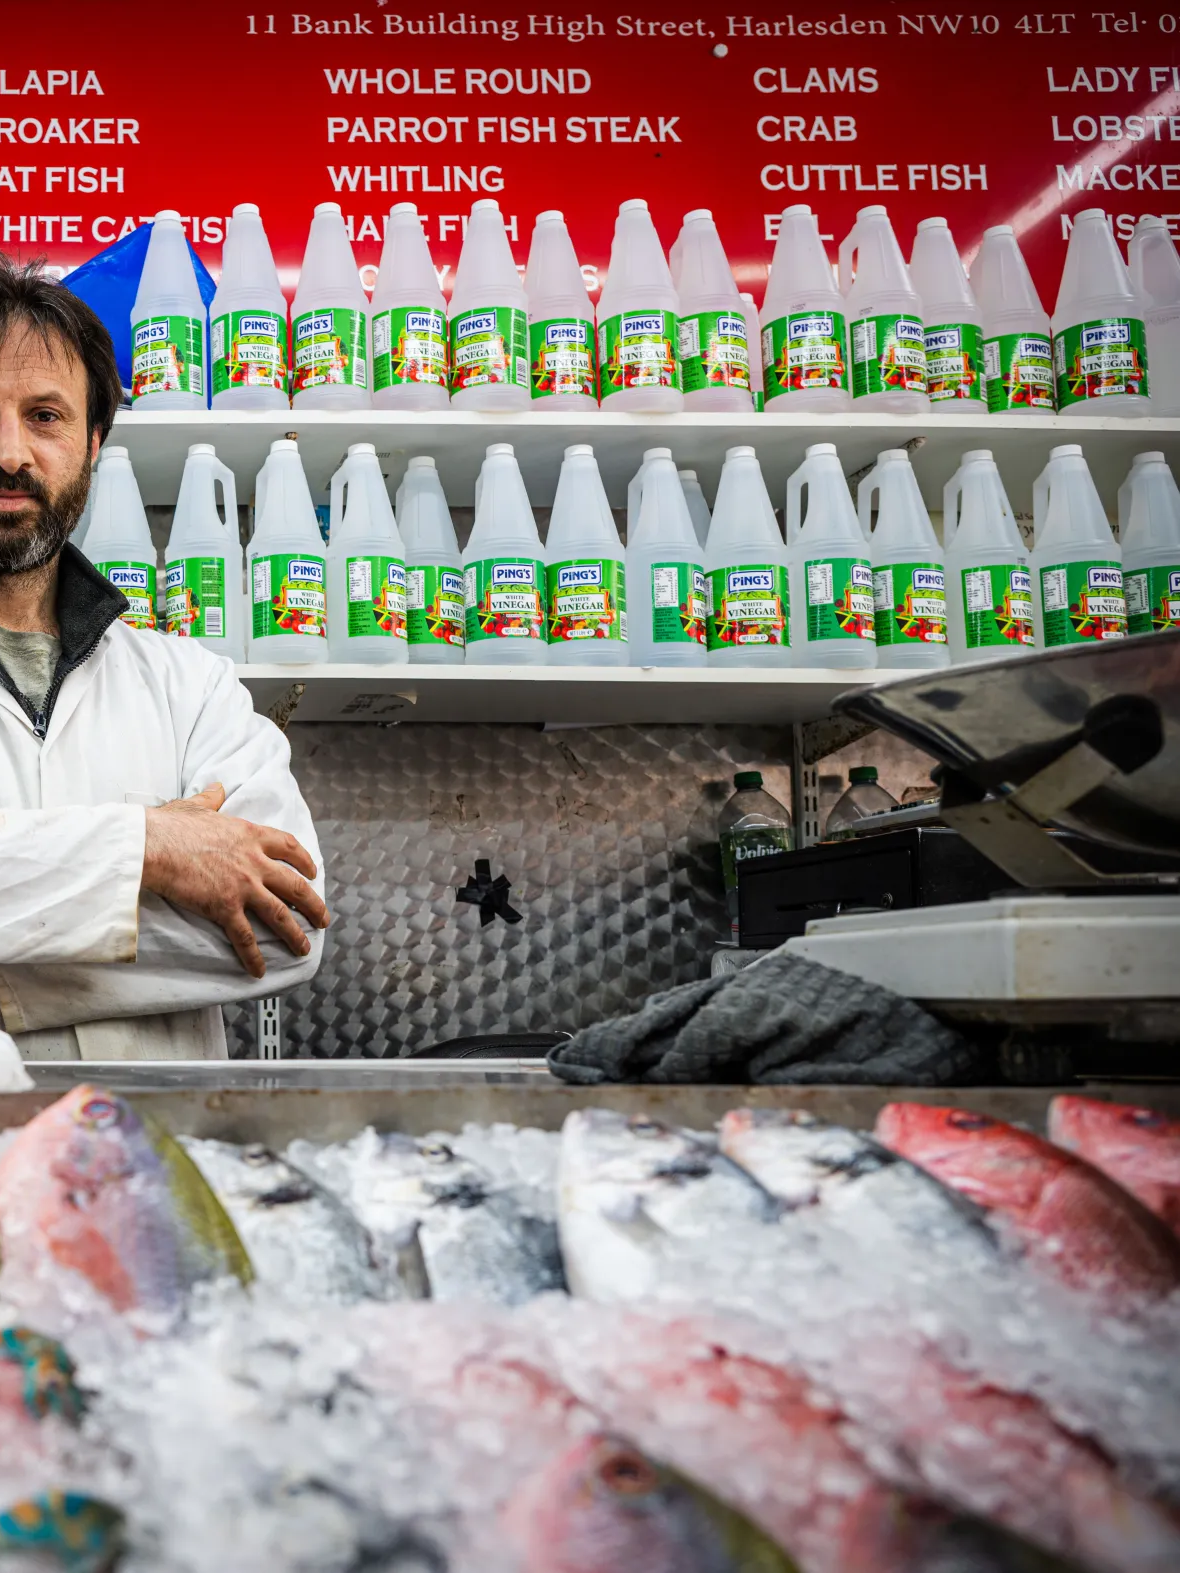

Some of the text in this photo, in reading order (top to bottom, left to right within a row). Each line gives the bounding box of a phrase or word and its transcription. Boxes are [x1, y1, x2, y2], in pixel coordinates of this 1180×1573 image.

[246, 14, 277, 35] 11
[292, 13, 375, 35] Bank
[384, 12, 519, 41] Building
[527, 14, 606, 42] High
[616, 14, 716, 38] Street,
[726, 14, 887, 37] Harlesden
[1015, 13, 1076, 34] 4LT
[1159, 13, 1180, 33] 0
[323, 68, 592, 95] WHOLE ROUND
[753, 67, 879, 93] CLAMS
[1046, 66, 1180, 92] LADY FI
[327, 116, 682, 143] PARROT FISH STEAK
[757, 115, 857, 142] CRAB
[1051, 115, 1180, 141] LOBSTE
[45, 166, 125, 193] FISH
[327, 165, 505, 192] WHITLING
[760, 164, 988, 191] CUTTLE FISH
[1056, 164, 1180, 190] MACKE
[91, 216, 154, 243] CA
[439, 215, 519, 242] FIH
[764, 214, 834, 241] EL
[238, 351, 280, 363] VINEGAR
[296, 348, 334, 365] VINEGAR
[456, 347, 497, 364] VINEGAR
[546, 357, 588, 368] VINEGAR
[620, 350, 666, 361] VINEGAR
[790, 352, 836, 364] VINEGAR
[1081, 360, 1134, 372] VINEGAR
[927, 364, 963, 374] NEGAR
[166, 570, 181, 583] NG'S
[127, 604, 149, 614] EGAR
[492, 600, 536, 610] VINEGAR
[558, 602, 604, 612] VINEGAR
[728, 606, 776, 617] VINEGAR
[914, 605, 946, 615] VINEGA
